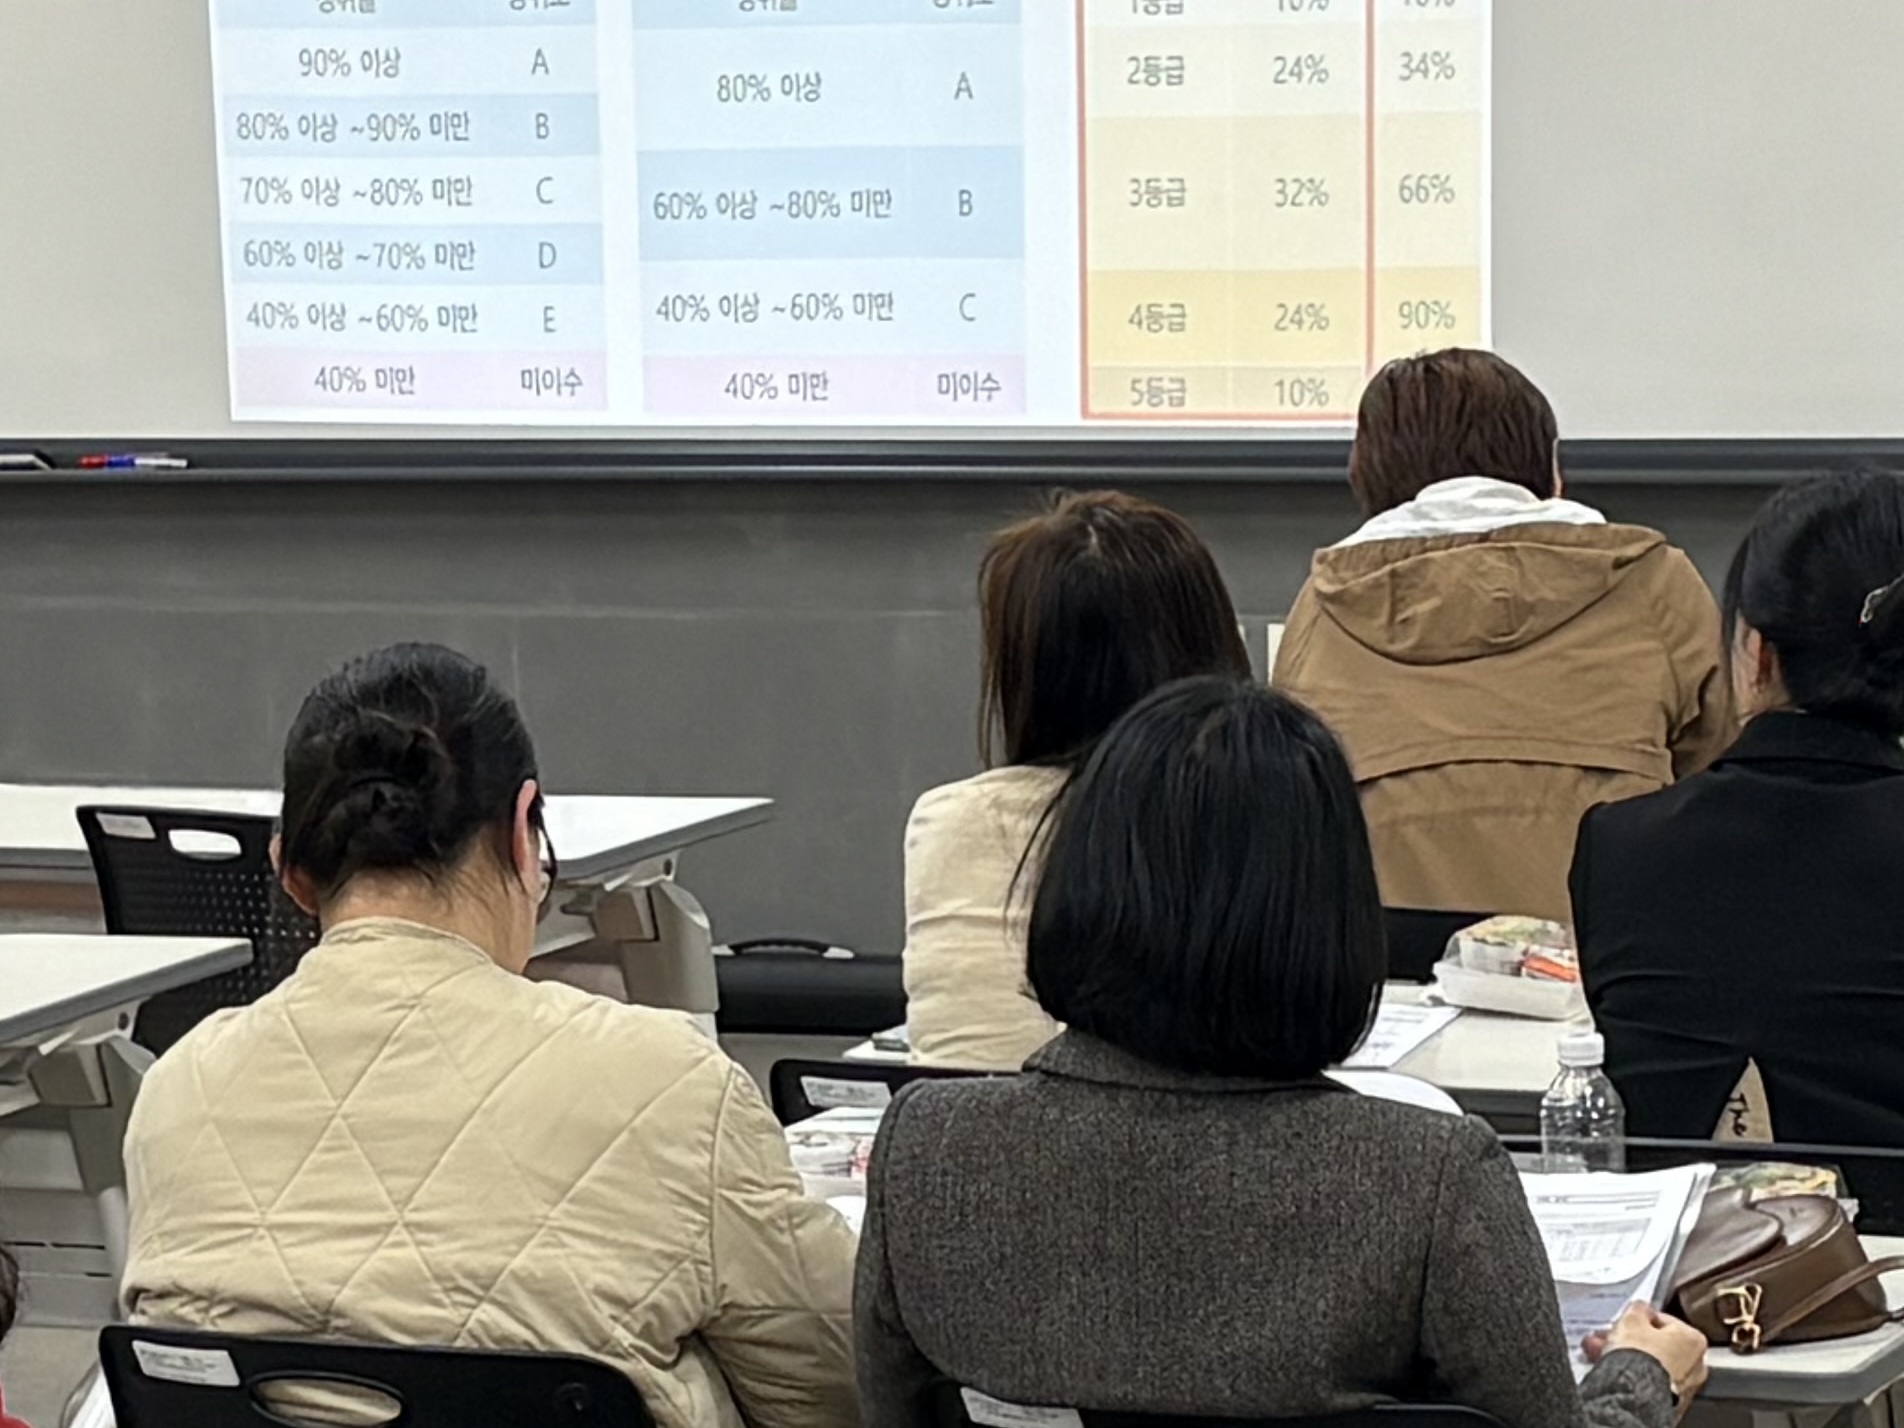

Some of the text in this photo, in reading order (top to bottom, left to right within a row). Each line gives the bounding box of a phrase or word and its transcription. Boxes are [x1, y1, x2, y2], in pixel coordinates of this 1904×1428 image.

[299, 47, 549, 78] 90% 이상 A
[1128, 51, 1455, 86] 2등급 24% 34%
[717, 72, 973, 102] 80% 이상 A
[654, 192, 707, 220] 60%
[716, 190, 757, 220] 이상
[851, 189, 892, 218] 미만
[959, 189, 972, 216] B
[1130, 174, 1455, 208] 3등급 32% 66%
[246, 302, 299, 329] 40%
[307, 303, 346, 332] 이상
[437, 304, 477, 333] 미만
[542, 306, 555, 334] E
[656, 294, 710, 322] 40%
[719, 293, 760, 323] 이상
[853, 293, 893, 321] 미만
[959, 293, 976, 322] C
[1128, 300, 1456, 333] 4등급 24% 90%
[314, 366, 583, 396] 40% 미만 미이수
[725, 372, 1001, 401] 40% 미만 미이수
